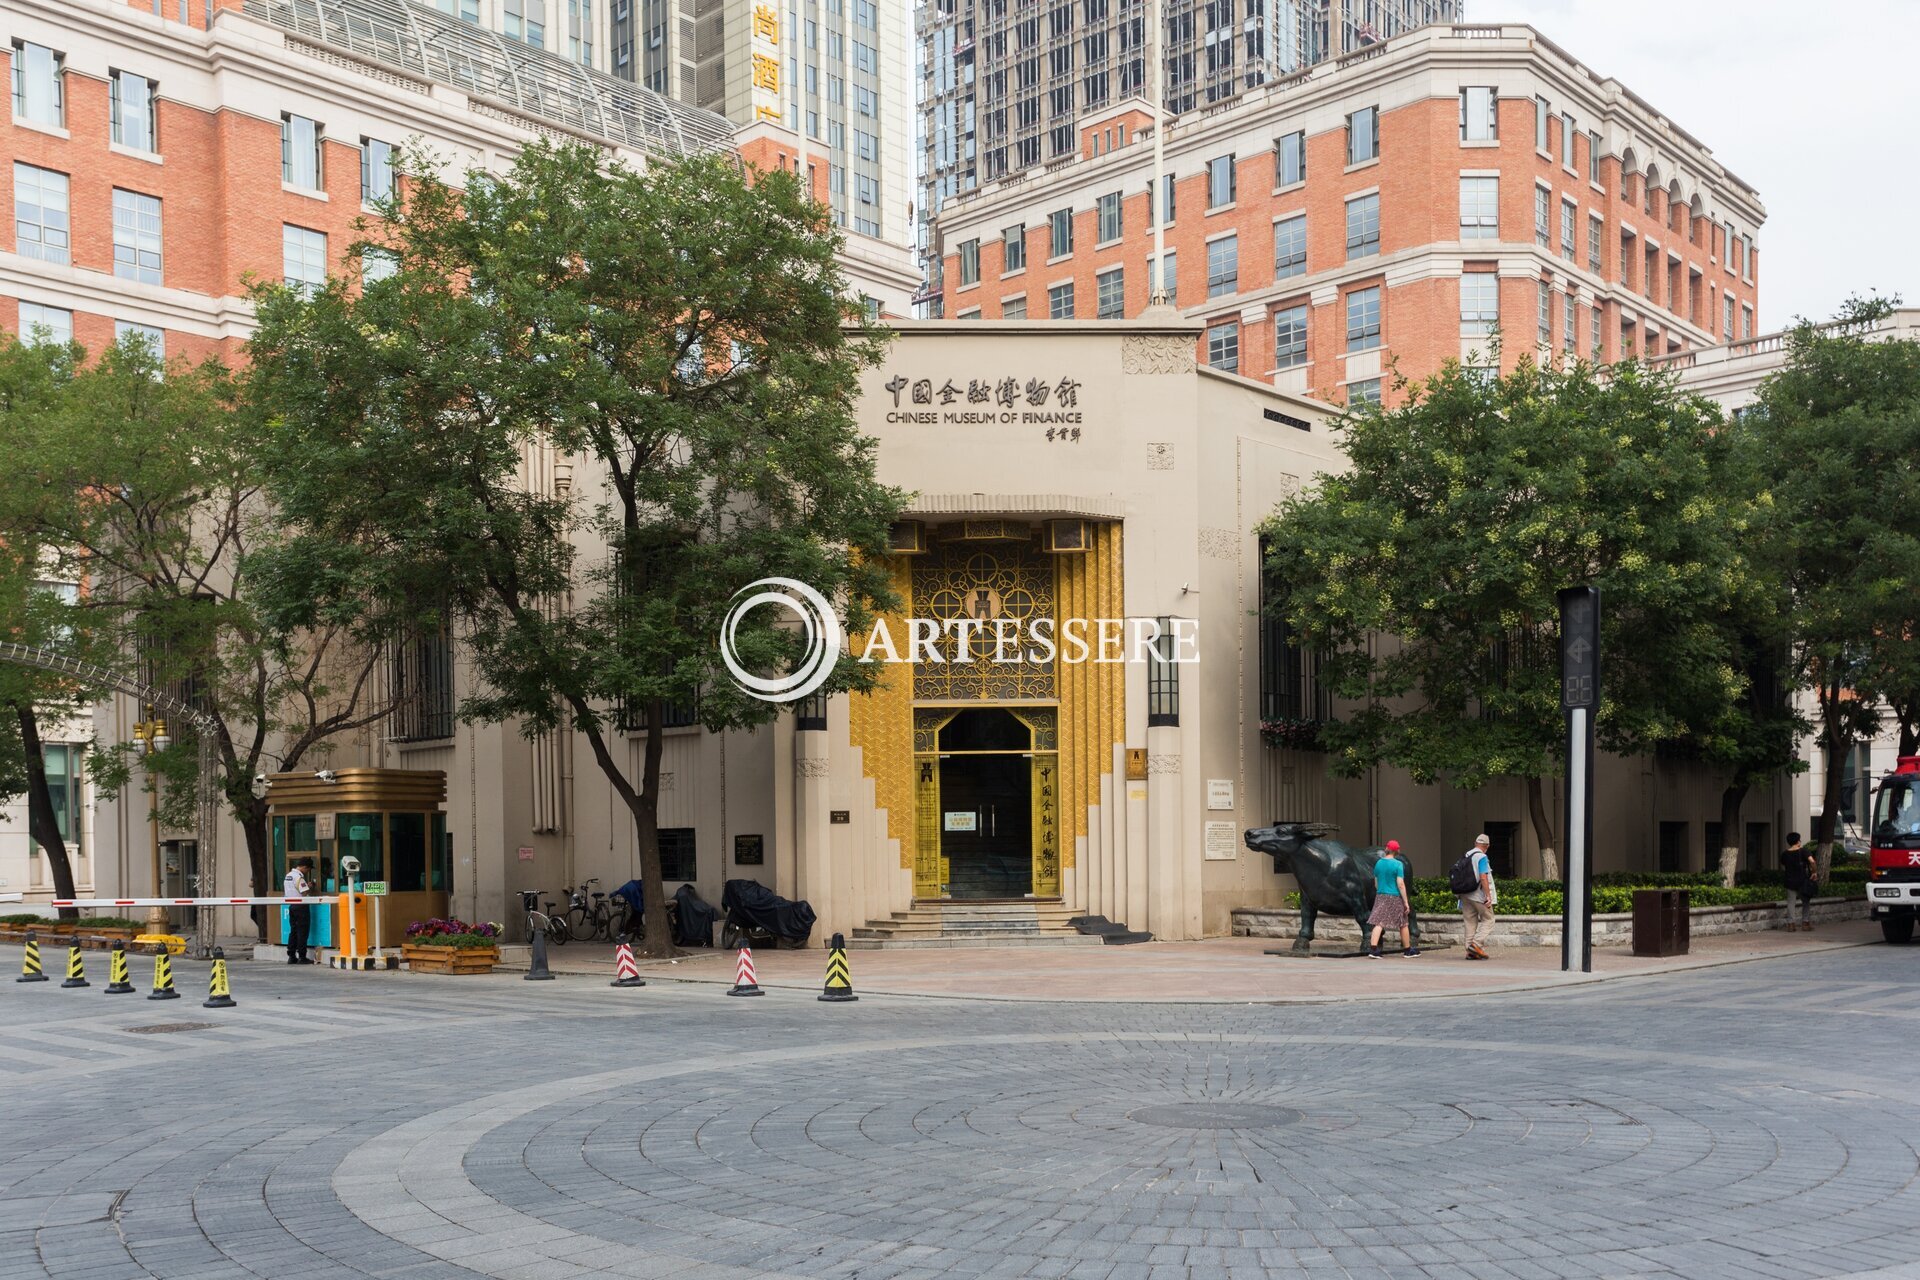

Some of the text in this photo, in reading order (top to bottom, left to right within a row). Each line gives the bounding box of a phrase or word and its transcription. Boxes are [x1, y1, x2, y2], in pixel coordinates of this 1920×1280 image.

[886, 412, 1082, 424] CHINESE MUSEUM OF FINANCE
